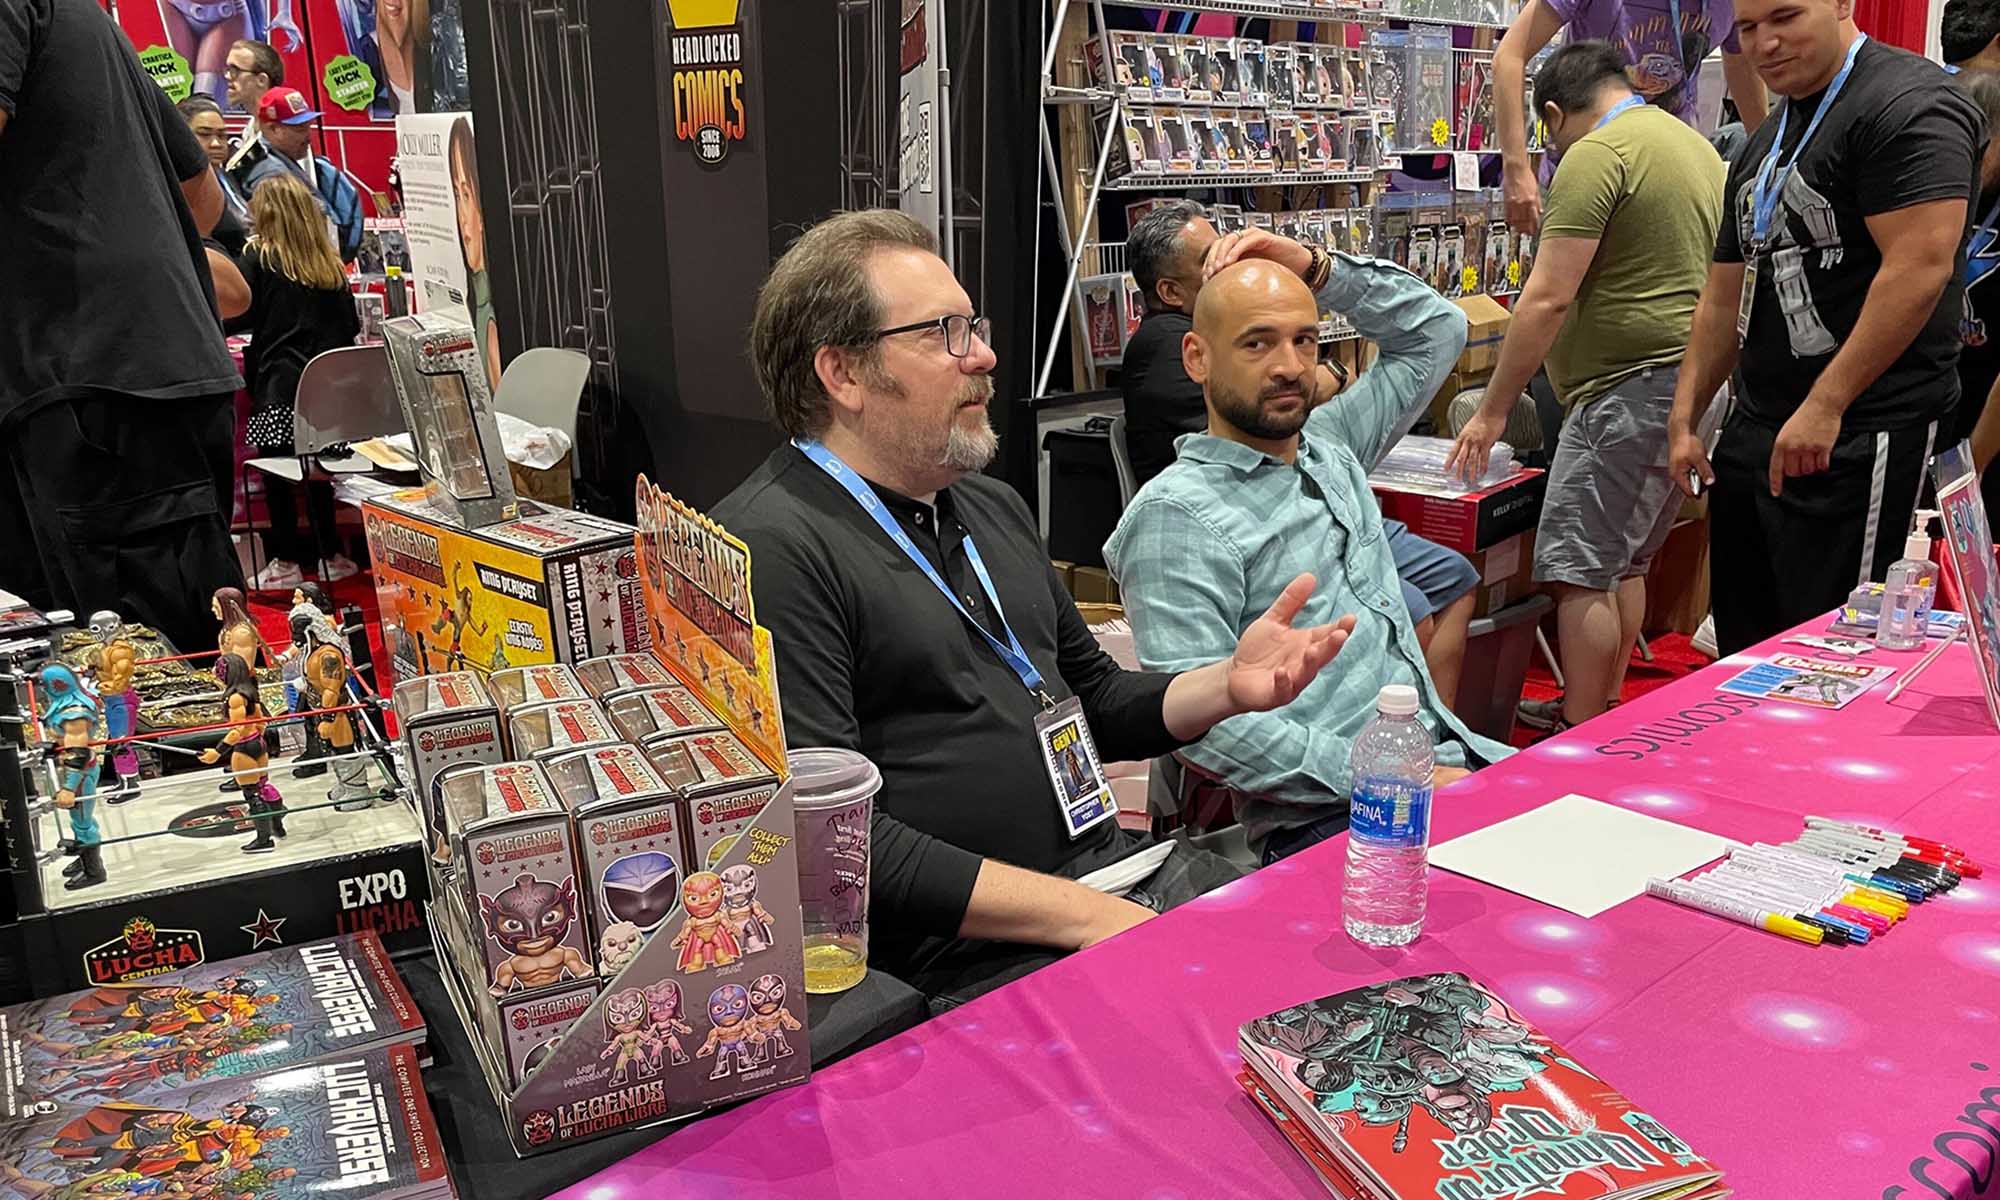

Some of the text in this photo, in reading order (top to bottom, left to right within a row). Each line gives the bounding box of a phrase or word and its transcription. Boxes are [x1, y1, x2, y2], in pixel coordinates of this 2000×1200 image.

[673, 33, 741, 65] HEADLOCKED
[145, 62, 177, 76] KICK
[334, 69, 362, 86] KICK
[673, 68, 746, 141] COMICS
[701, 129, 721, 144] SINCE
[655, 487, 751, 626] LEGENDS
[563, 562, 589, 661] RING PLAYSET
[608, 809, 670, 834] LEGENDS
[749, 828, 793, 847] COLLECT
[496, 830, 561, 853] LEGENDS
[752, 841, 778, 856] THEM
[338, 868, 408, 910] EXPO
[336, 900, 421, 938] LUCHA
[92, 942, 199, 982] LUCHA
[120, 964, 177, 983] CENTRAL
[298, 942, 377, 1038] LUCHAVERSE
[323, 1059, 390, 1182] LUCHAVERSE
[397, 1066, 414, 1098] COMPLETE
[413, 1131, 432, 1169] COLLECTION
[556, 1080, 666, 1128] LEGENDS
[560, 1100, 668, 1138] OF LUCHA LIBRE
